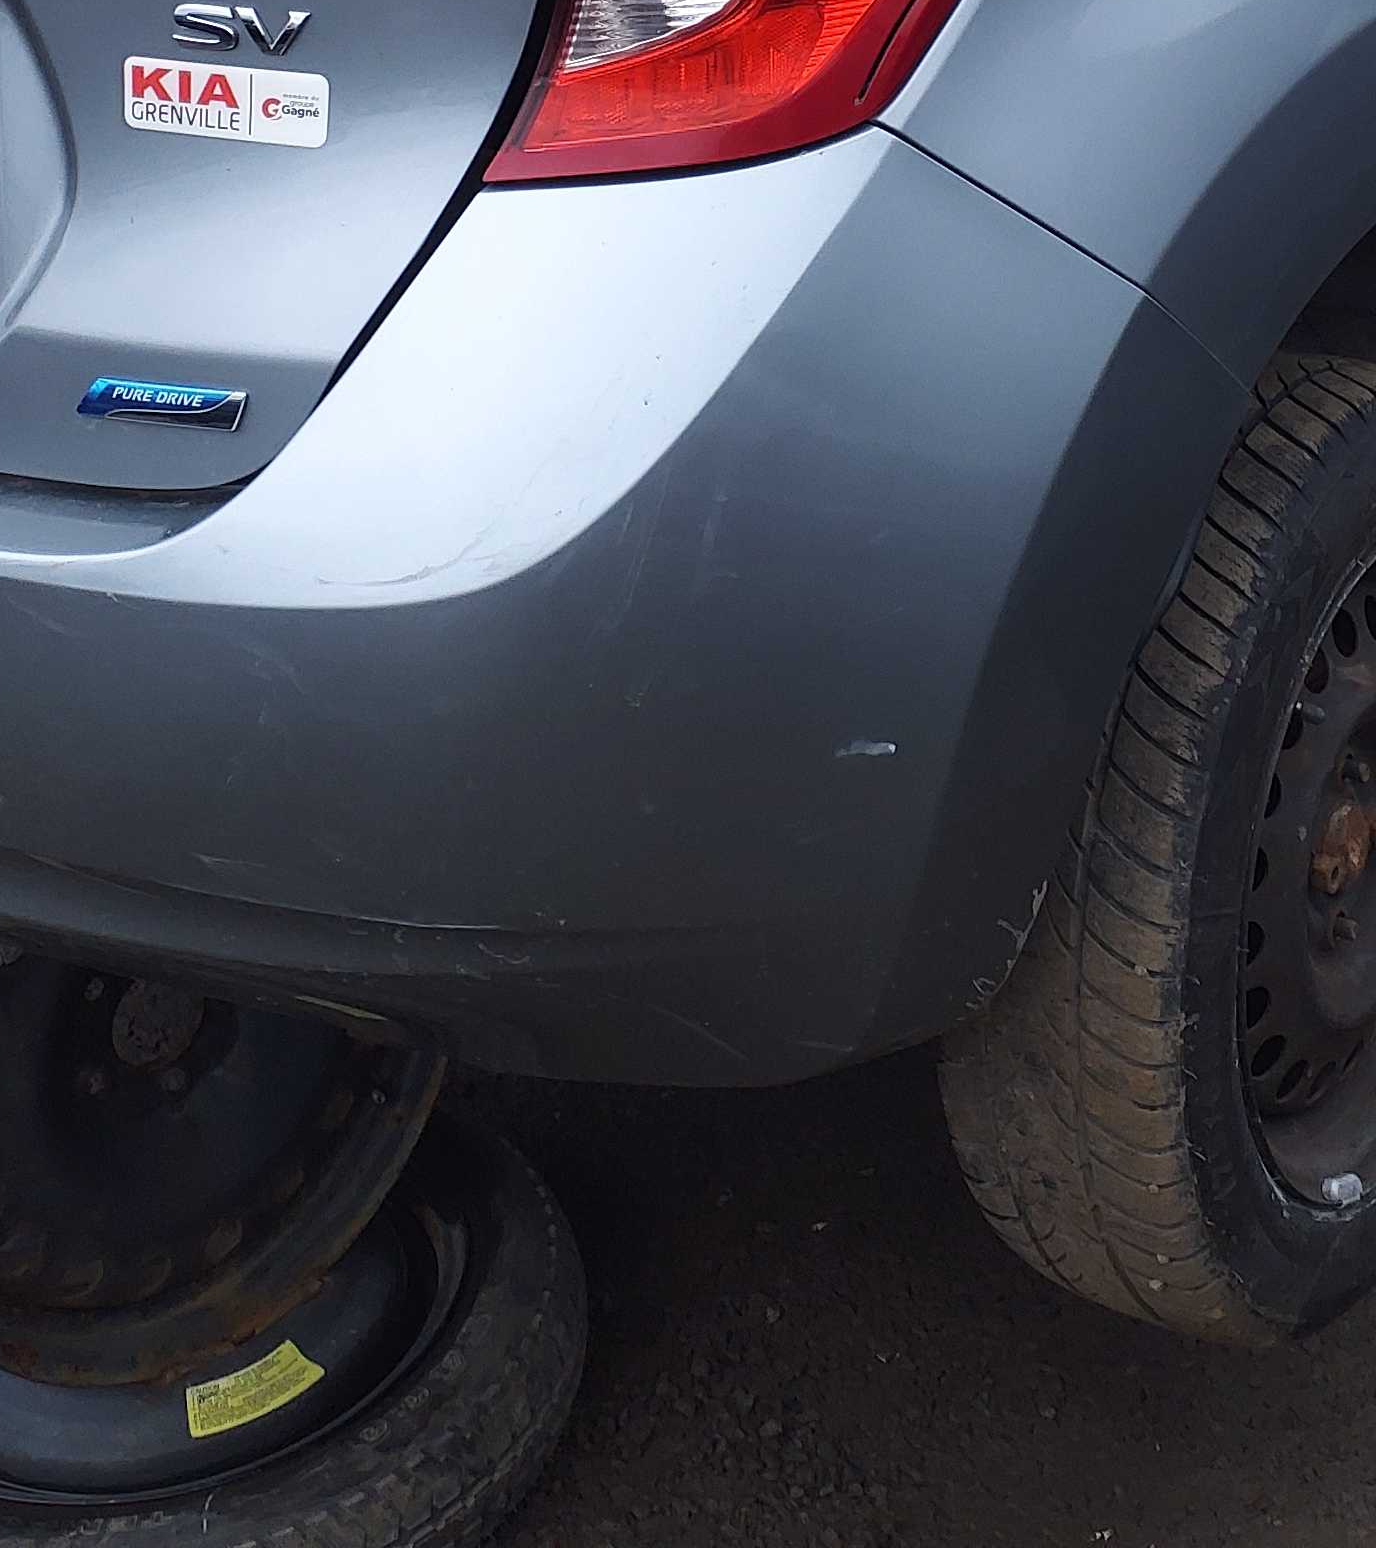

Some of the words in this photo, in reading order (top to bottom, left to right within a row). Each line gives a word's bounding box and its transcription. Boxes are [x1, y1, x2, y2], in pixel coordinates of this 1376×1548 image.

[171, 2, 313, 56] SV
[130, 64, 241, 109] KIA
[131, 101, 241, 132] GRENVILLE
[281, 104, 320, 119] Gagné
[112, 385, 152, 402] PURE
[155, 391, 204, 408] DRIVE
